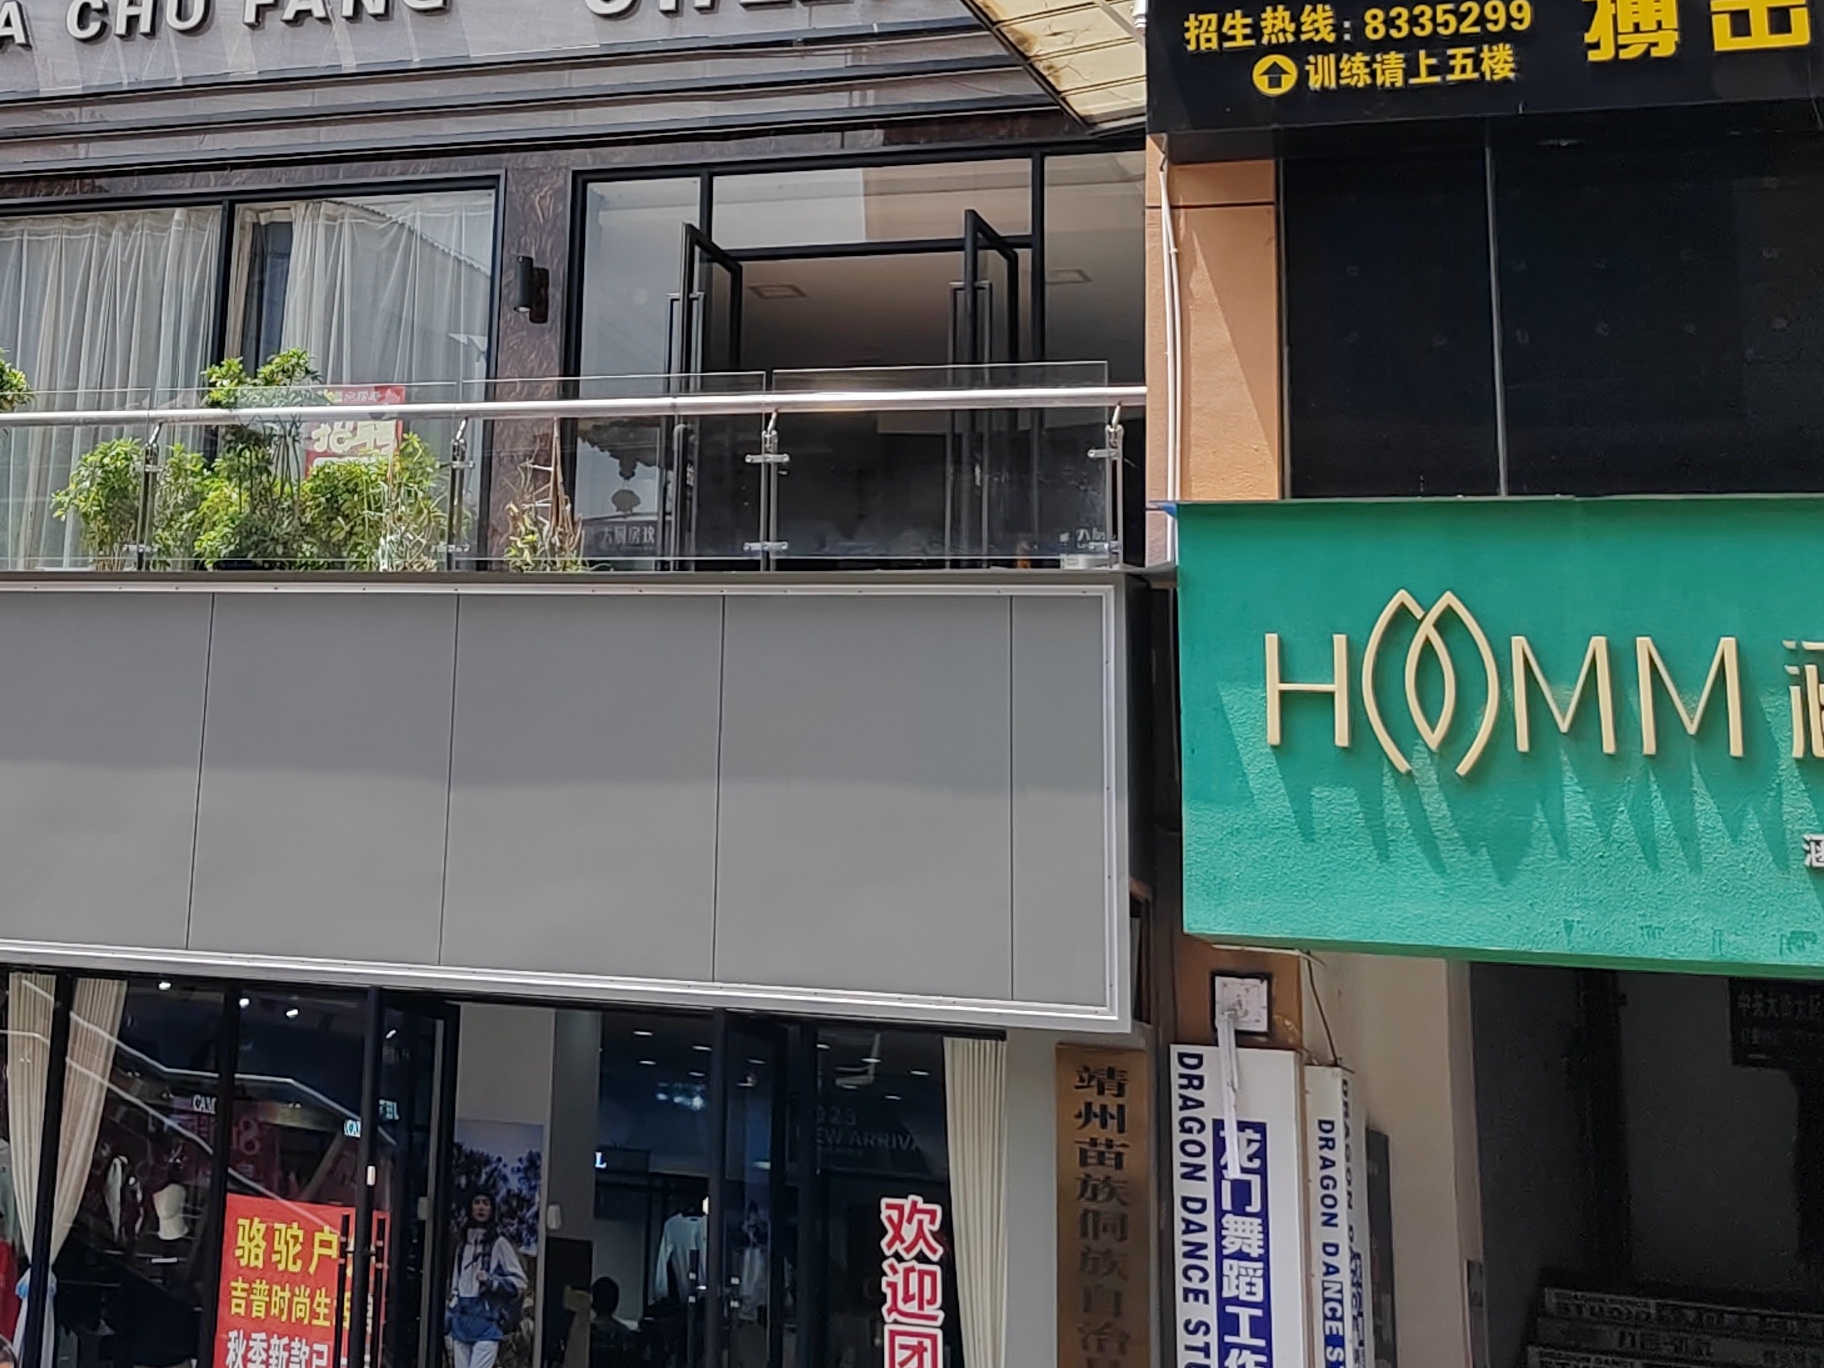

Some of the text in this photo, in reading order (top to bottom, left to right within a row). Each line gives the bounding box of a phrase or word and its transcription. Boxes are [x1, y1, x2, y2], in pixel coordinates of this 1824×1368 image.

[1305, 42, 1516, 90] 训练请上五楼
[1177, 1051, 1209, 1183] DRAGON
[1317, 1118, 1339, 1229] DRAGON
[235, 1216, 354, 1275] 骆驼户
[880, 1193, 945, 1368] 欢迎团
[1180, 1195, 1211, 1306] DANCE
[1322, 1241, 1344, 1337] DANCE
[230, 1276, 352, 1331] 吉普时尚生
